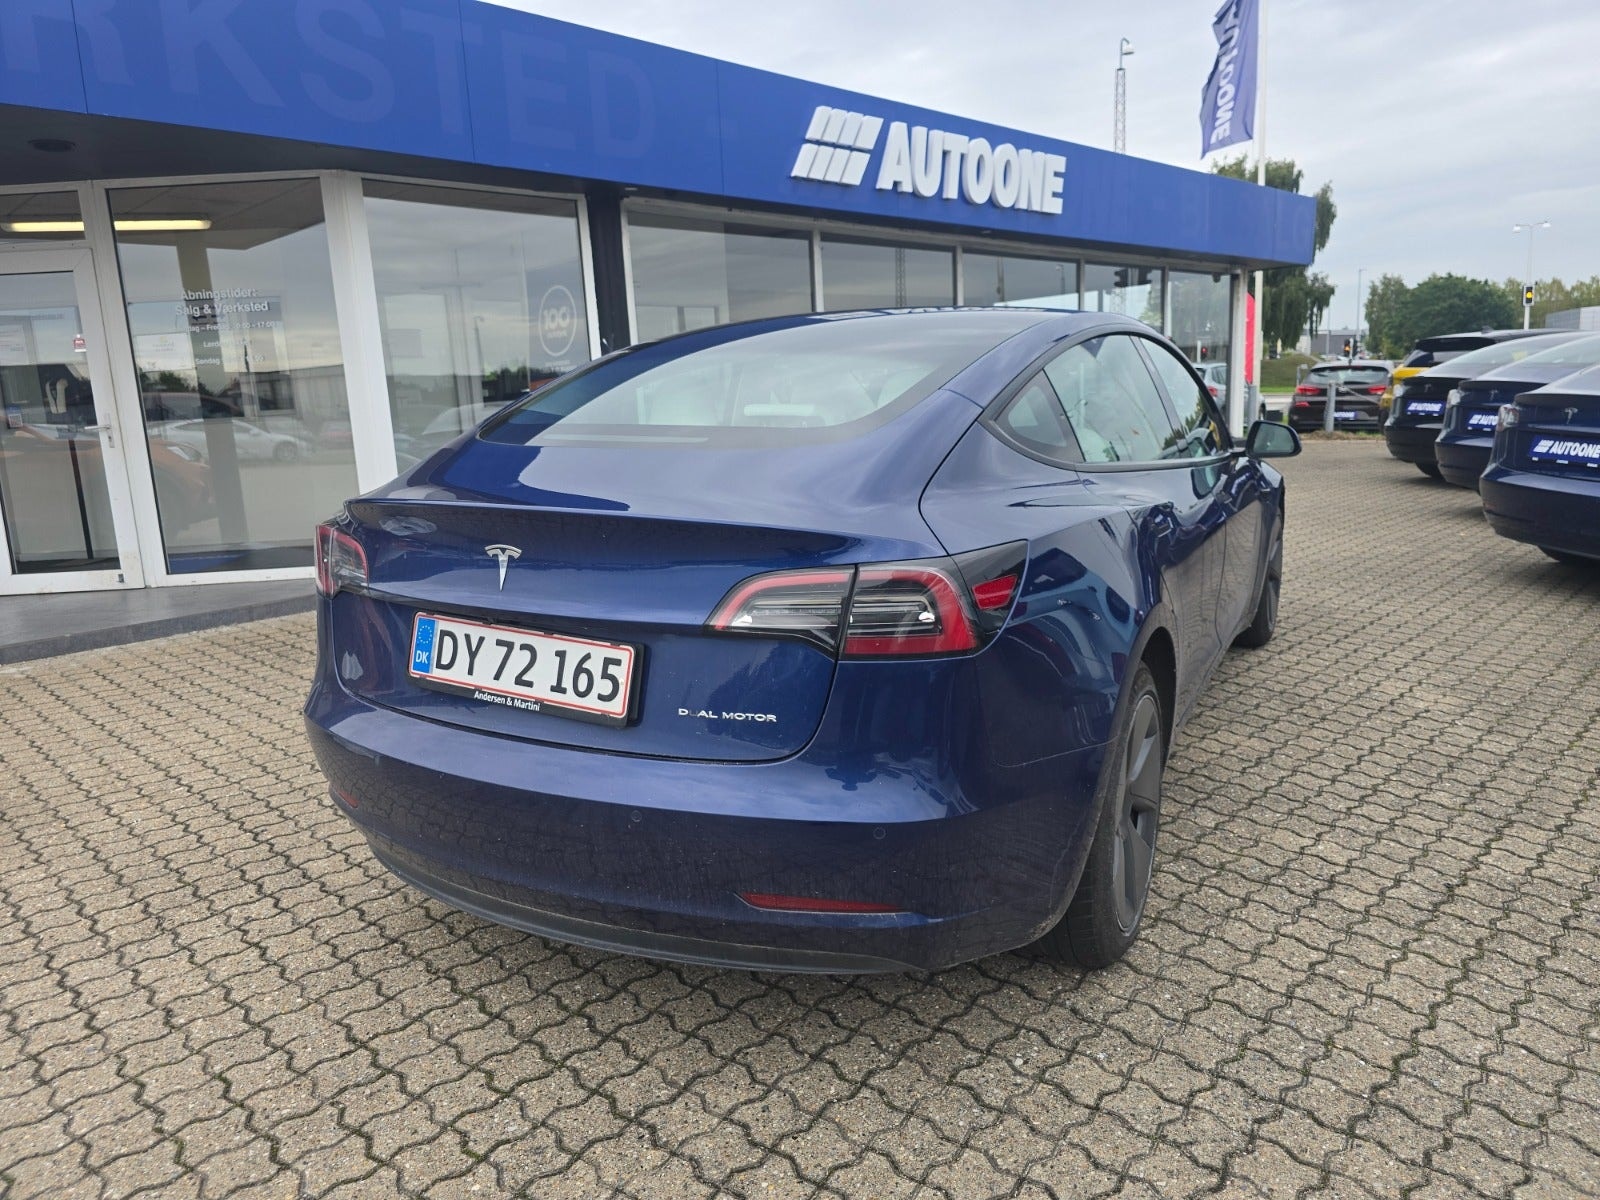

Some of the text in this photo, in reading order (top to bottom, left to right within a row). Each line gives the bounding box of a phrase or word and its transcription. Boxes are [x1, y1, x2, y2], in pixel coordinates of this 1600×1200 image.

[876, 121, 1067, 214] AUTOONE
[176, 301, 269, 316] Salg & Værksted
[1549, 440, 1600, 459] AUTOONE
[415, 650, 428, 664] DK
[435, 629, 622, 702] DY 72 165
[474, 690, 541, 712] Andersen & Martini
[722, 711, 777, 722] MOTOR
